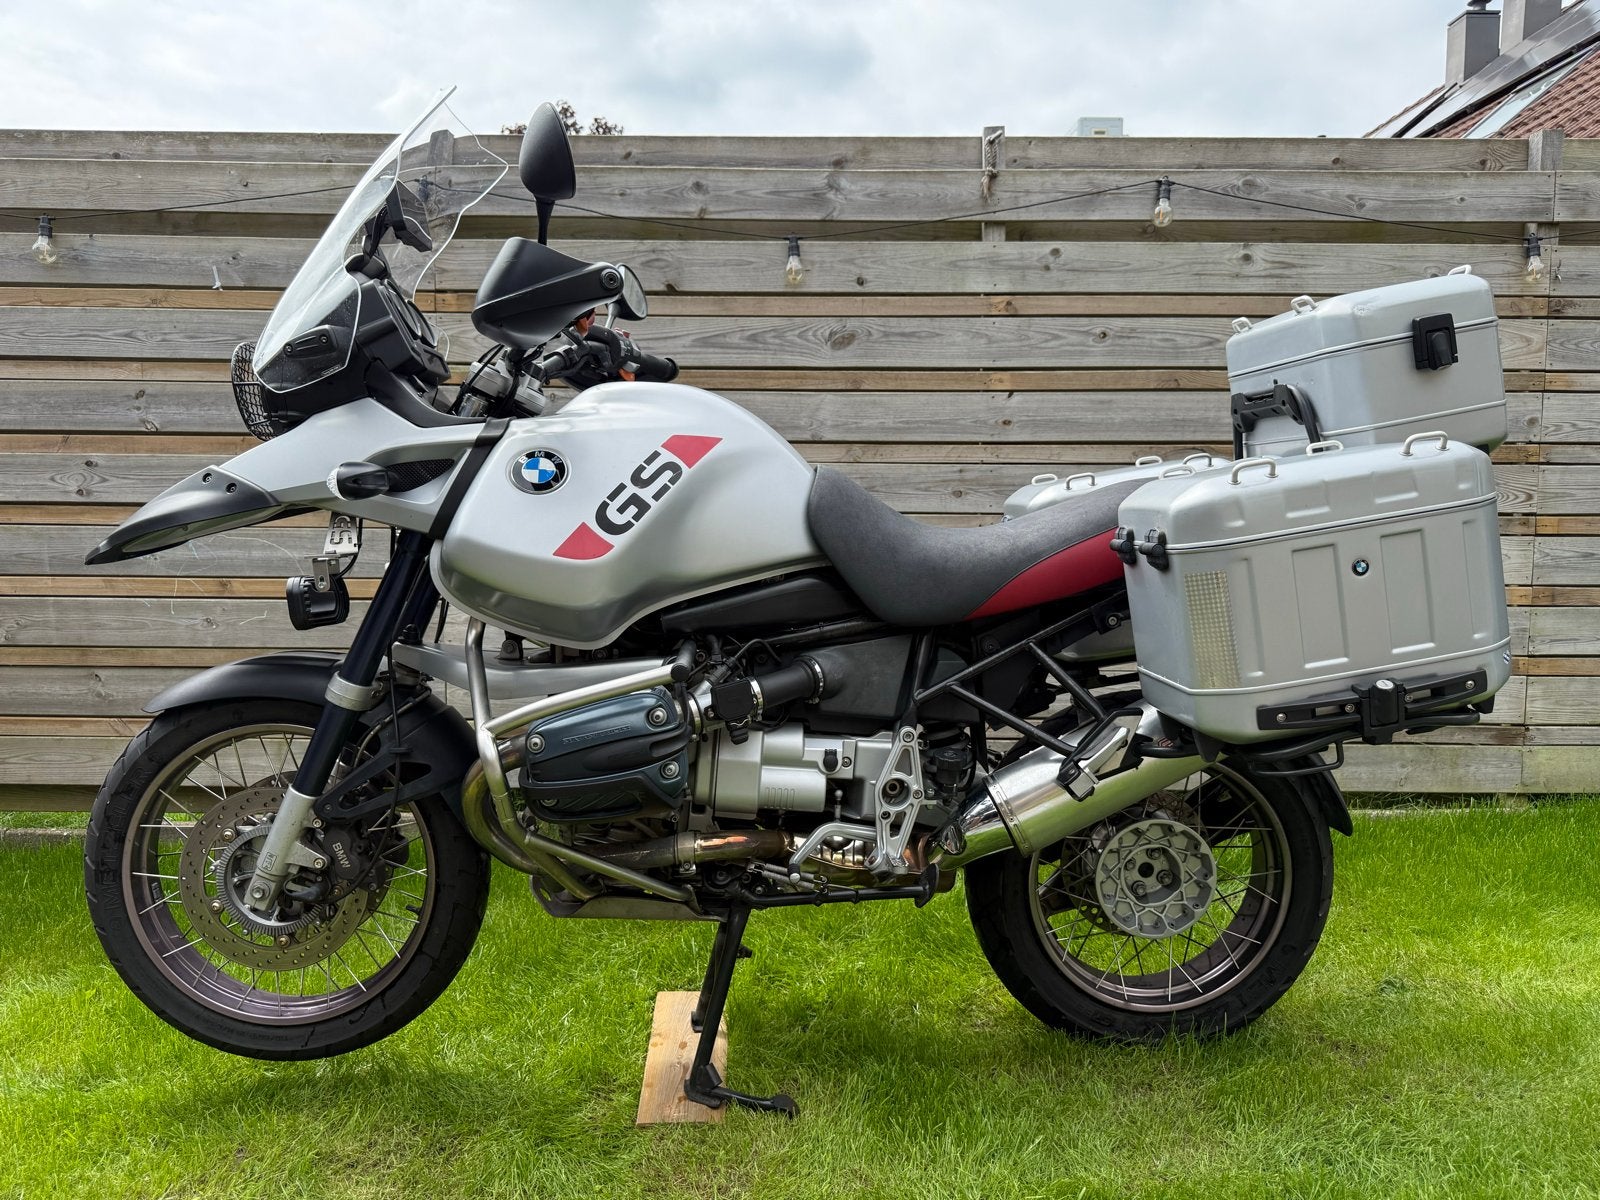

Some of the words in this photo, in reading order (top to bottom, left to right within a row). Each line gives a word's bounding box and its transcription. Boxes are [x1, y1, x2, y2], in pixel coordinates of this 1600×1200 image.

[518, 450, 562, 465] BMW
[595, 450, 683, 536] GS
[329, 515, 353, 545] GS
[332, 842, 351, 869] BMW
